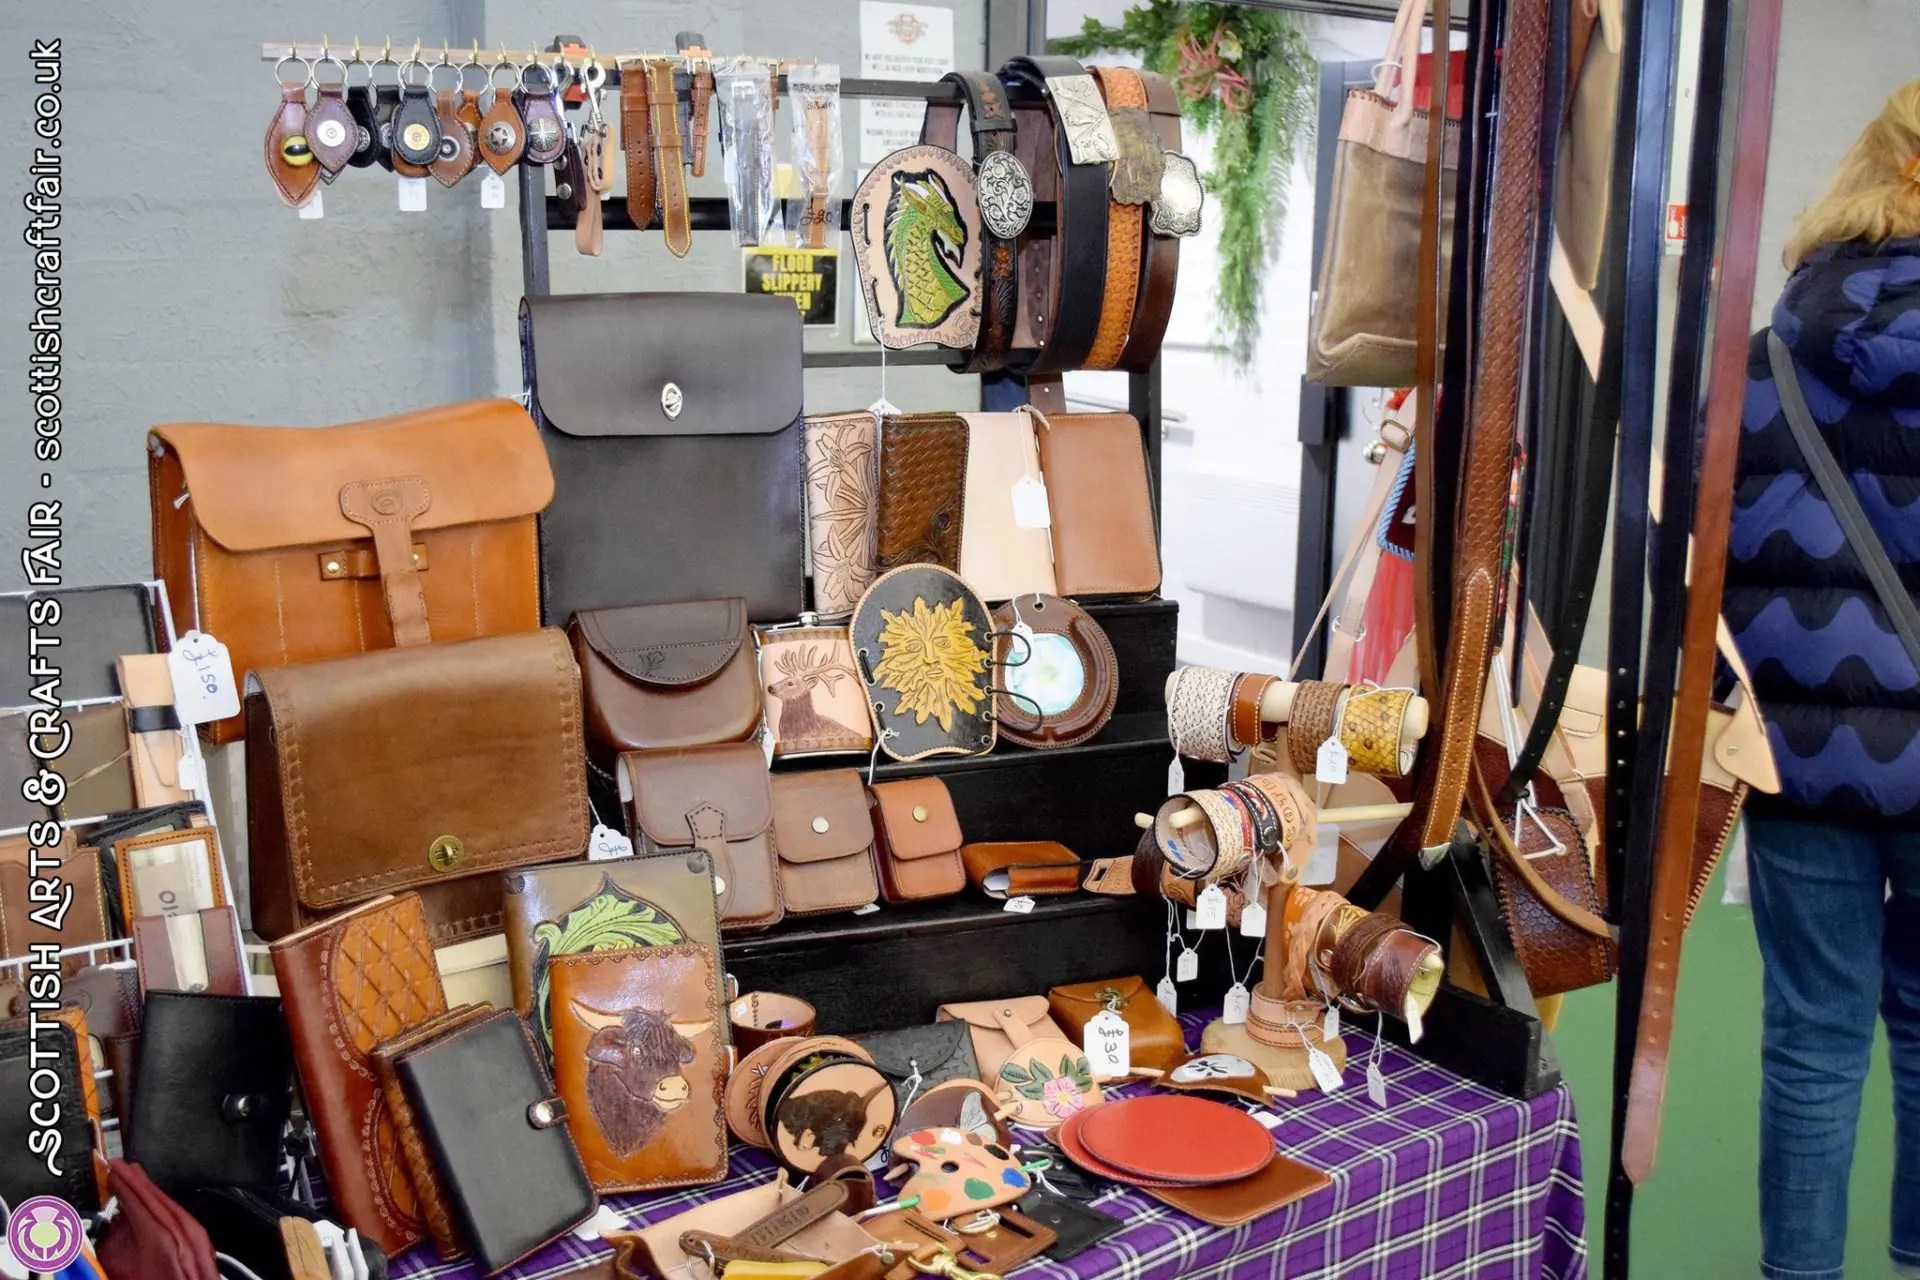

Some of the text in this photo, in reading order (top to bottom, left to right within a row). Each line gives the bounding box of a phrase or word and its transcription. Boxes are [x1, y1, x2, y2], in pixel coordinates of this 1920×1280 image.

[771, 254, 814, 273] FLOOR
[761, 272, 824, 292] SLIPPERY
[774, 292, 812, 311] EN
